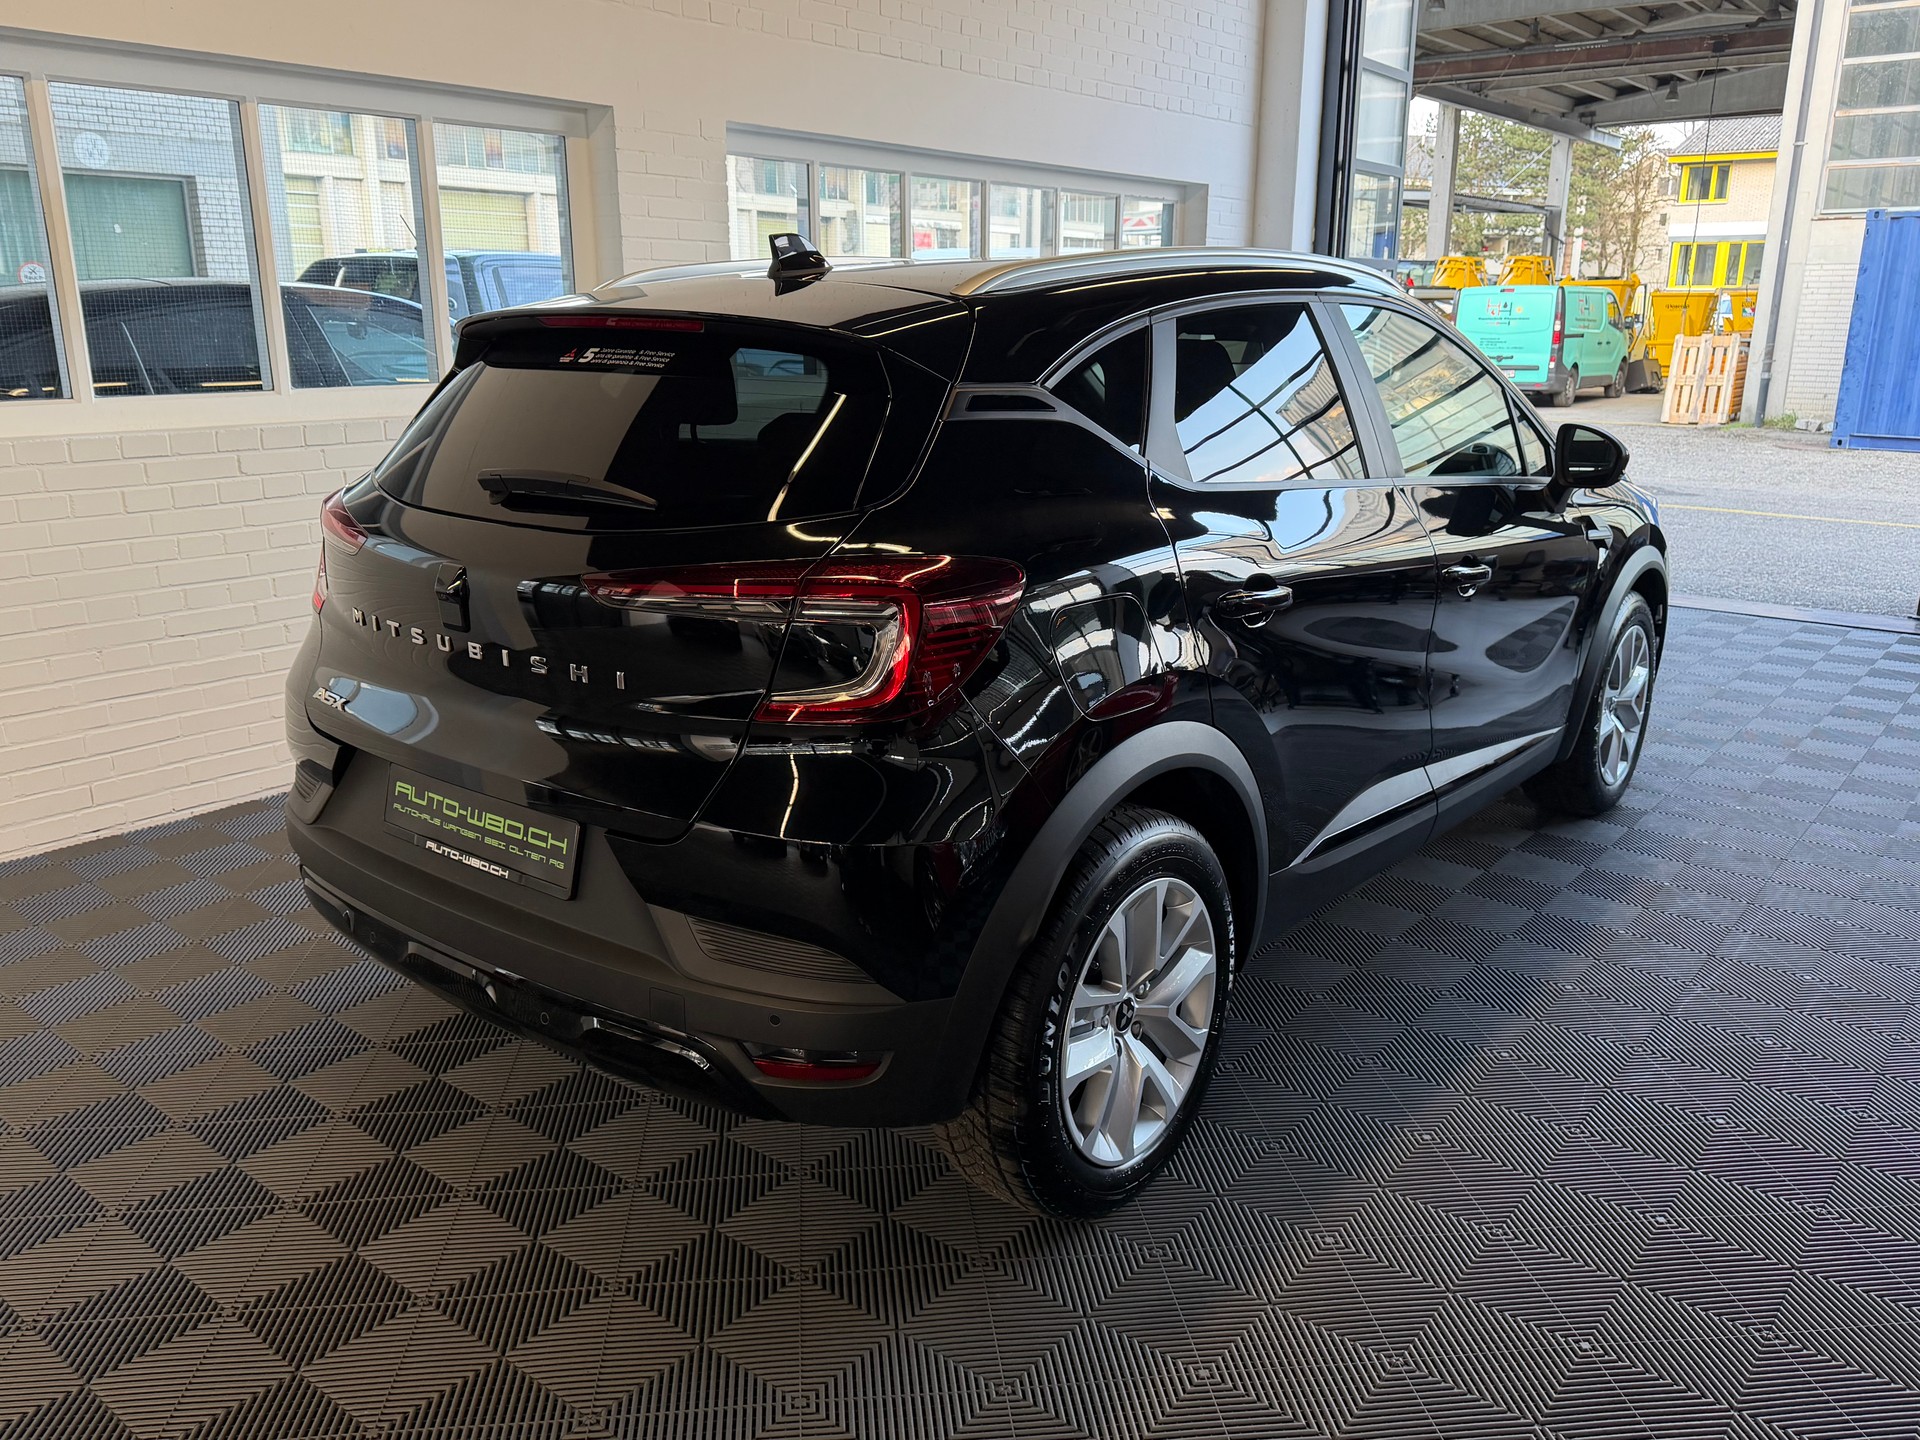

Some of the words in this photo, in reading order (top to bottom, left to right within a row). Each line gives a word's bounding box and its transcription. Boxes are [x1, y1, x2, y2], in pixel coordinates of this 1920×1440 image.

[577, 347, 601, 363] 5
[646, 361, 665, 369] Service
[352, 606, 626, 690] MITSUBISHI
[312, 687, 346, 712] ASX
[393, 802, 441, 826] AUTOHAUS
[484, 836, 507, 850] BEI
[508, 844, 547, 863] OLTEN
[548, 858, 565, 870] AG
[395, 781, 568, 855] AUTO-WBO.CH
[425, 840, 509, 879] AUTO-WBO.CH
[1038, 932, 1083, 1105] DUNLOP
